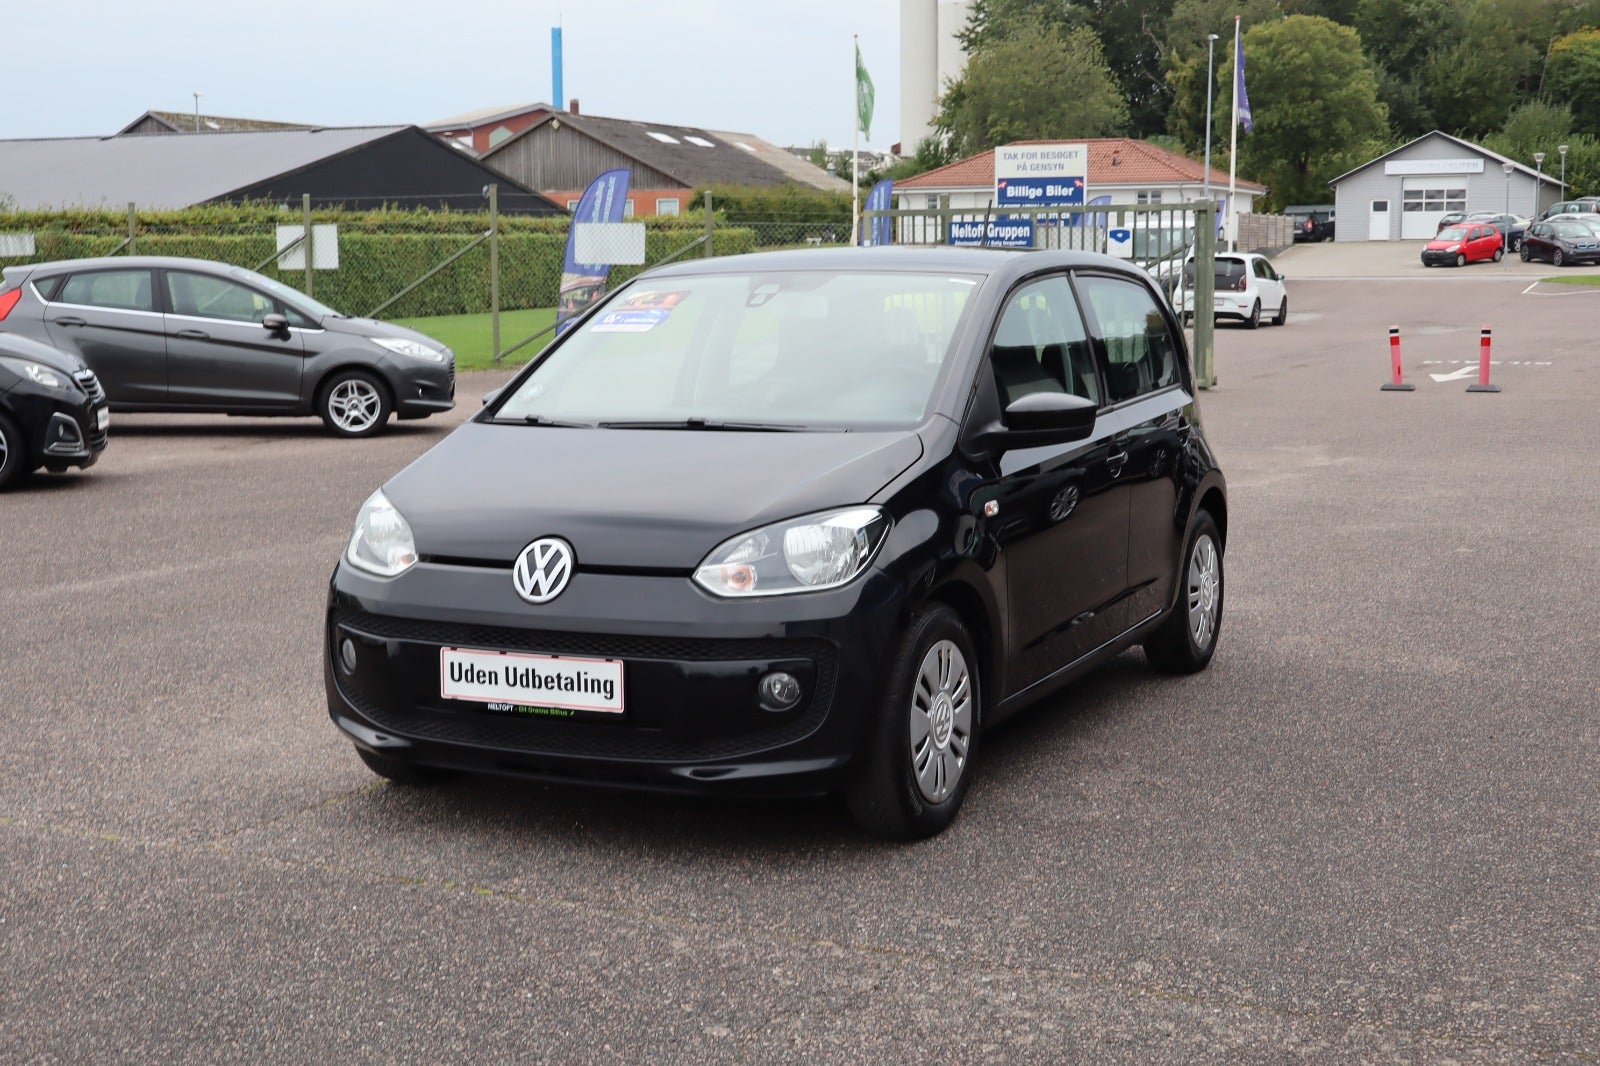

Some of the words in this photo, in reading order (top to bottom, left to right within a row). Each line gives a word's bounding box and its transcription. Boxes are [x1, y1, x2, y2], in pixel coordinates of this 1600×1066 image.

[1003, 152, 1018, 160] TAK
[1021, 152, 1038, 160] FOR
[1040, 151, 1079, 159] BESØGET
[1016, 162, 1027, 171] PÅ
[1030, 163, 1064, 171] GENSYN
[1006, 185, 1043, 199] Billige
[1046, 185, 1074, 196] Biler
[951, 223, 985, 239] Neltoft
[987, 223, 1030, 241] Gruppen
[514, 539, 571, 602] VW
[450, 661, 499, 686] Uden
[505, 666, 614, 701] Udbetaling
